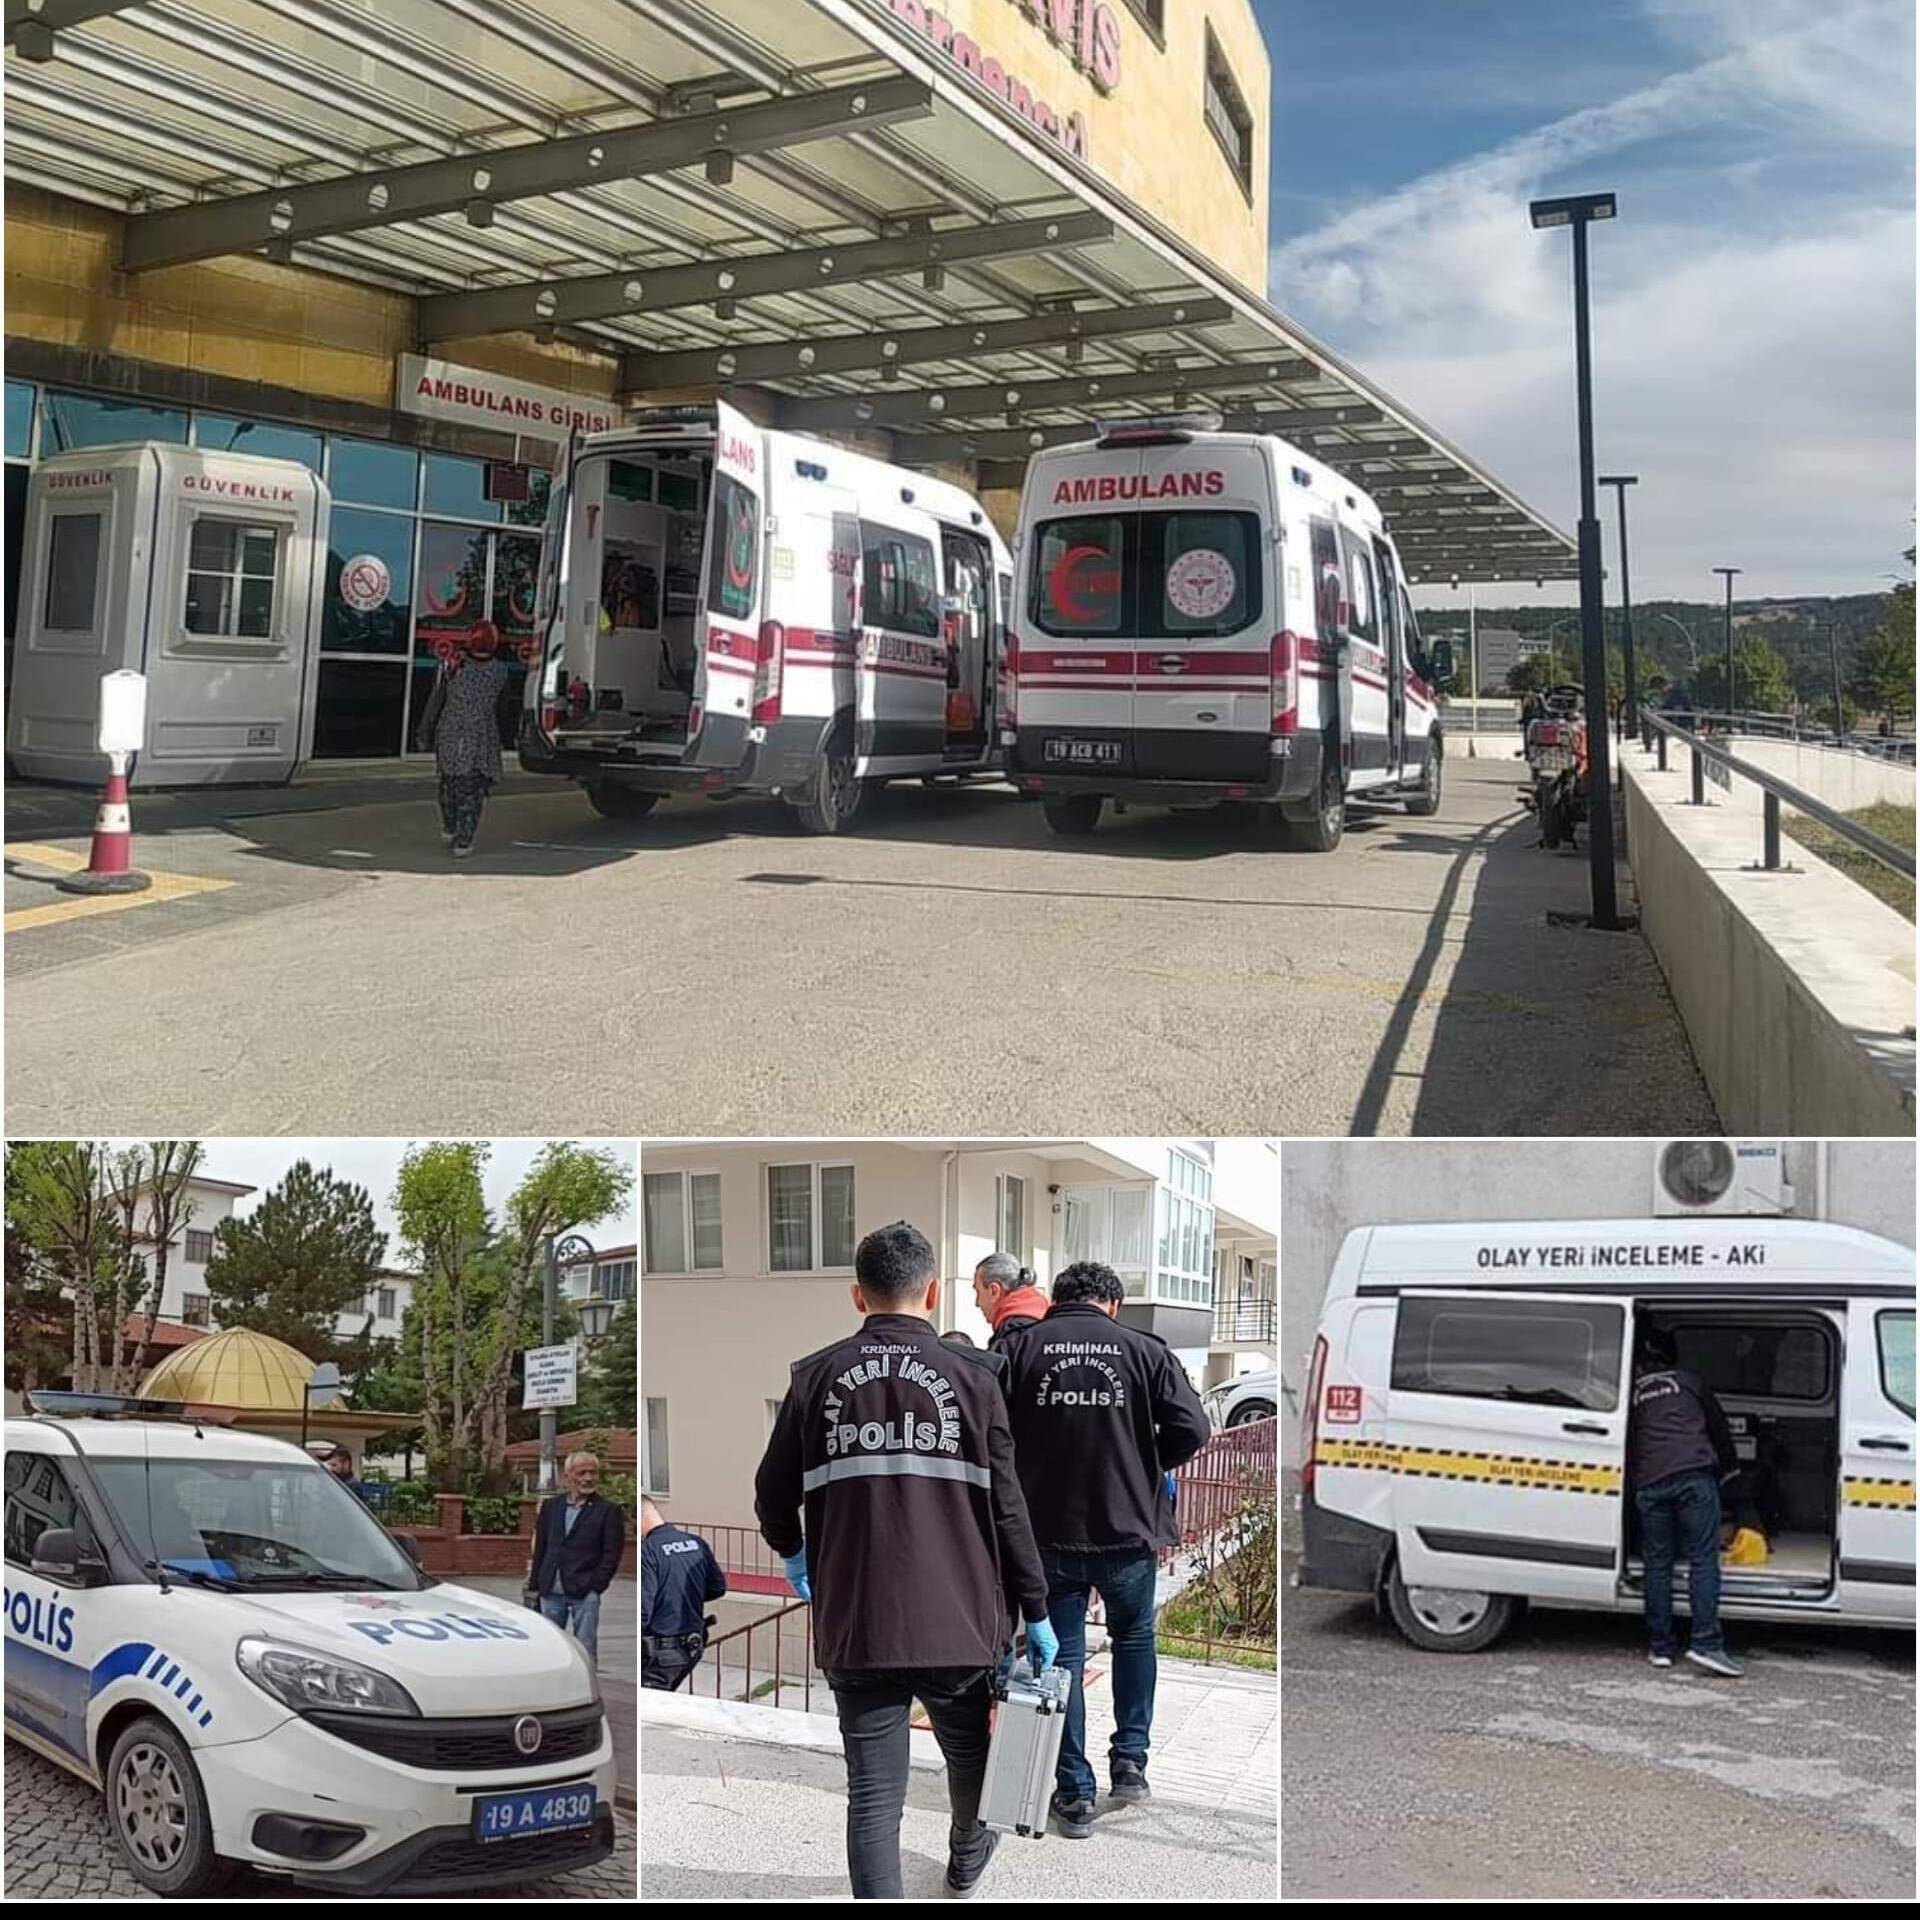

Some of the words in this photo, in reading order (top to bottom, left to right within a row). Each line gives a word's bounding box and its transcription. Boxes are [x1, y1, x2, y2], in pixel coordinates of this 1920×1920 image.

[417, 376, 543, 420] AMBULANS
[183, 475, 295, 502] GÜVENLİK
[1053, 470, 1224, 504] AMBULANS
[1477, 1247, 1531, 1268] OLAY
[1050, 1388, 1111, 1406] POLİS
[1331, 1388, 1357, 1407] 112
[824, 1390, 844, 1456] OLAY
[838, 1411, 937, 1454] POLİS
[346, 1612, 531, 1645] POLİS
[487, 1805, 514, 1830] 19
[519, 1801, 535, 1826] A
[541, 1794, 591, 1820] 4830
